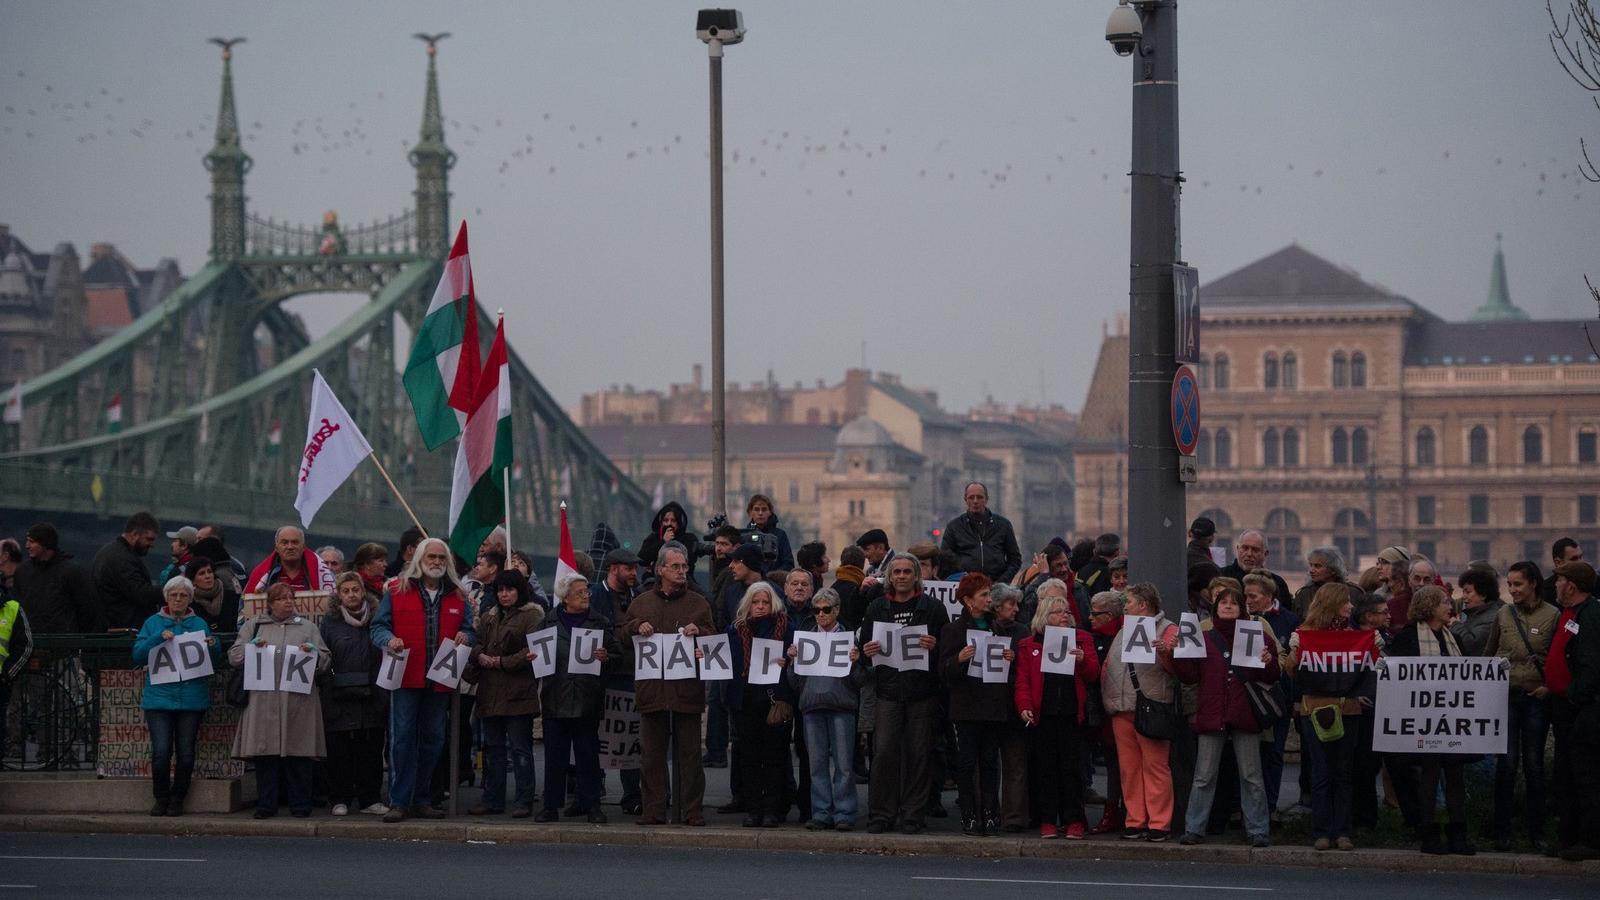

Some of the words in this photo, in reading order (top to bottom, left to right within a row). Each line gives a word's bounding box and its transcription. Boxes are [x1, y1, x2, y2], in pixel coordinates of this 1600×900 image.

[1298, 650, 1375, 672] ANTIFA
[1380, 664, 1390, 680] A
[1398, 660, 1507, 680] DIKTATÚRÁK
[1410, 691, 1475, 708] IDEJE
[1383, 714, 1500, 736] LEJÁRT!
